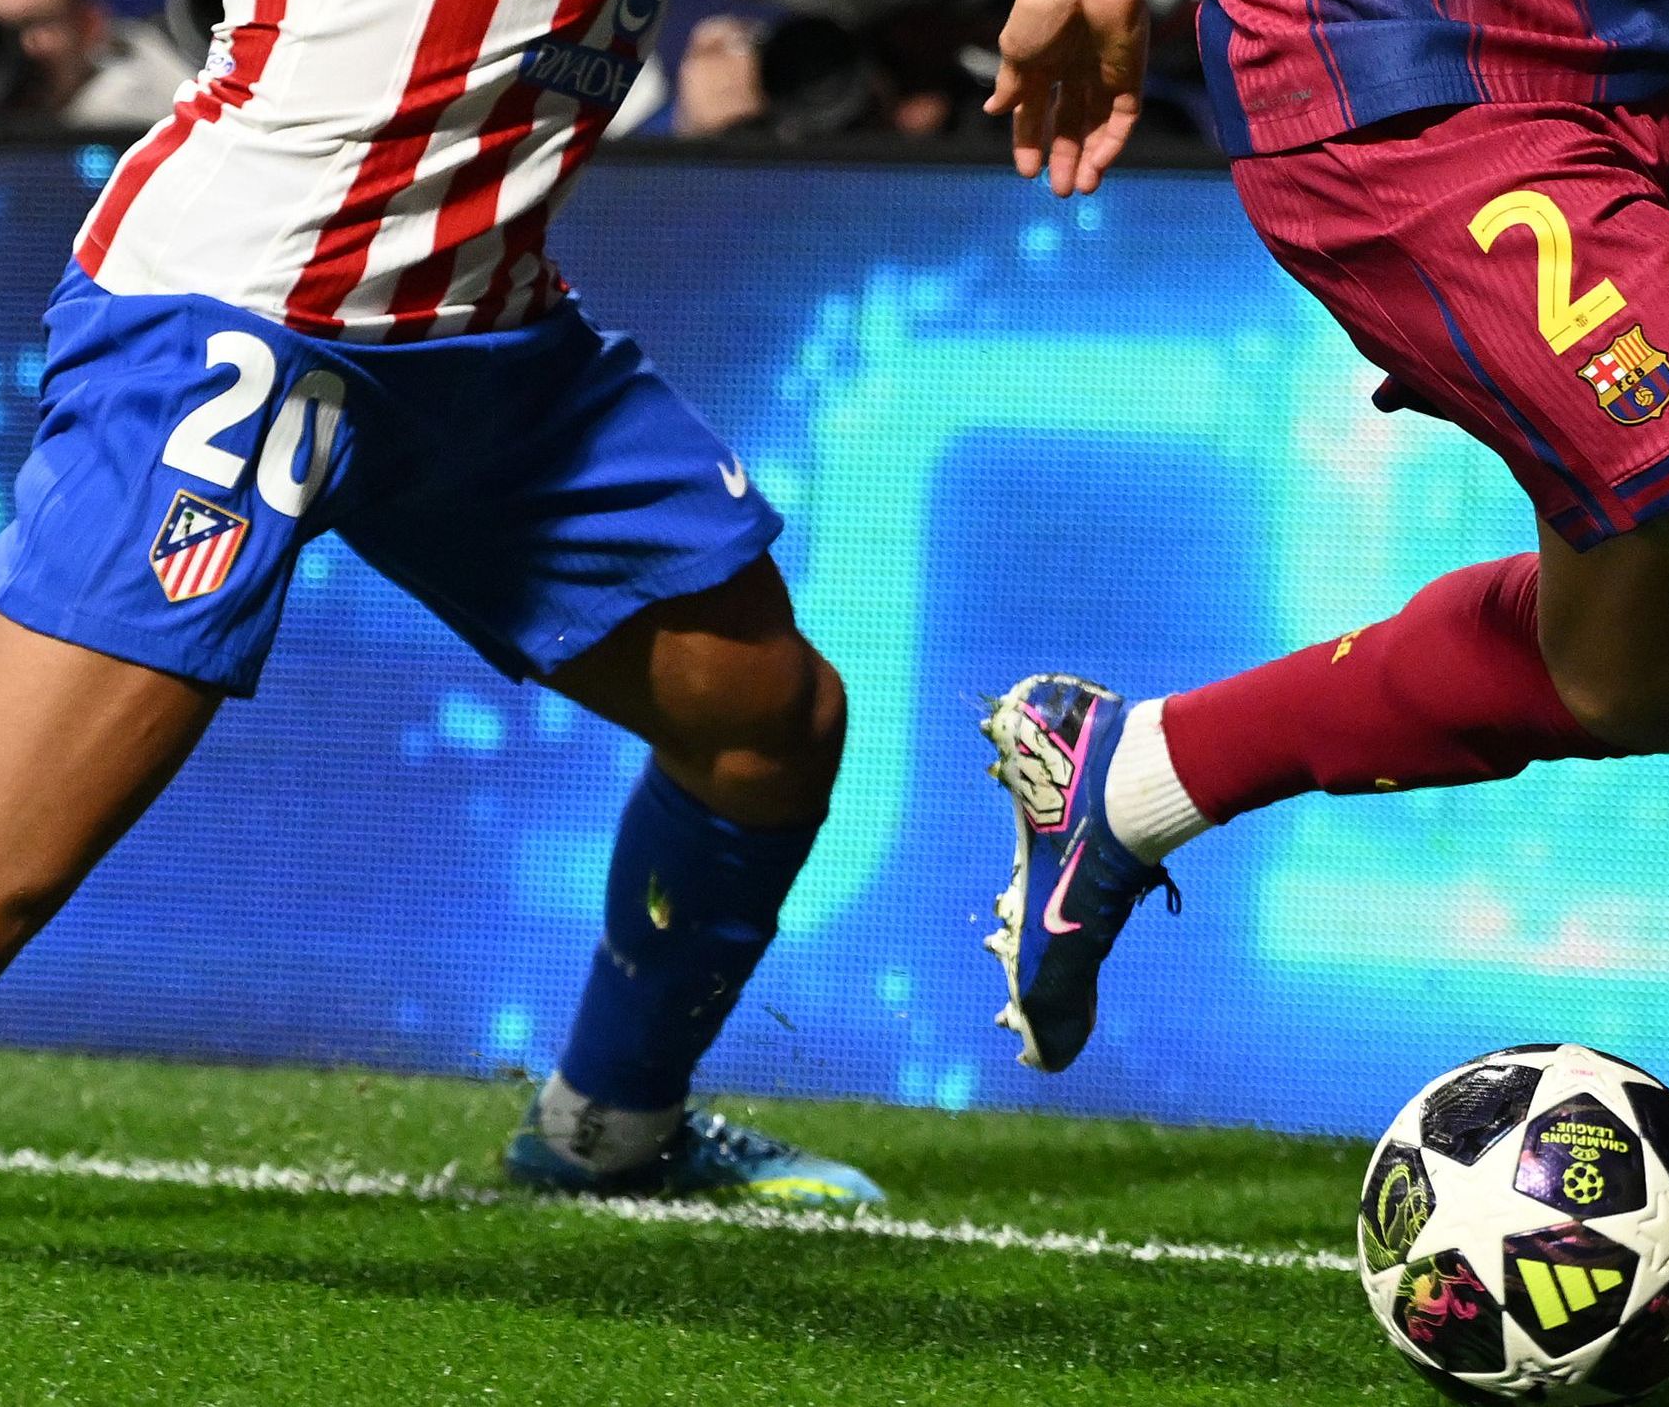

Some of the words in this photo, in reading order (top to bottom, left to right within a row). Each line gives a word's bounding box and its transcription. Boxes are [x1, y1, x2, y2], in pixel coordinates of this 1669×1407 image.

[1467, 190, 1628, 356] 2
[162, 330, 346, 518] 20
[1540, 1132, 1629, 1153] CHAMPIONS
[1556, 1122, 1614, 1139] LEAGUE
